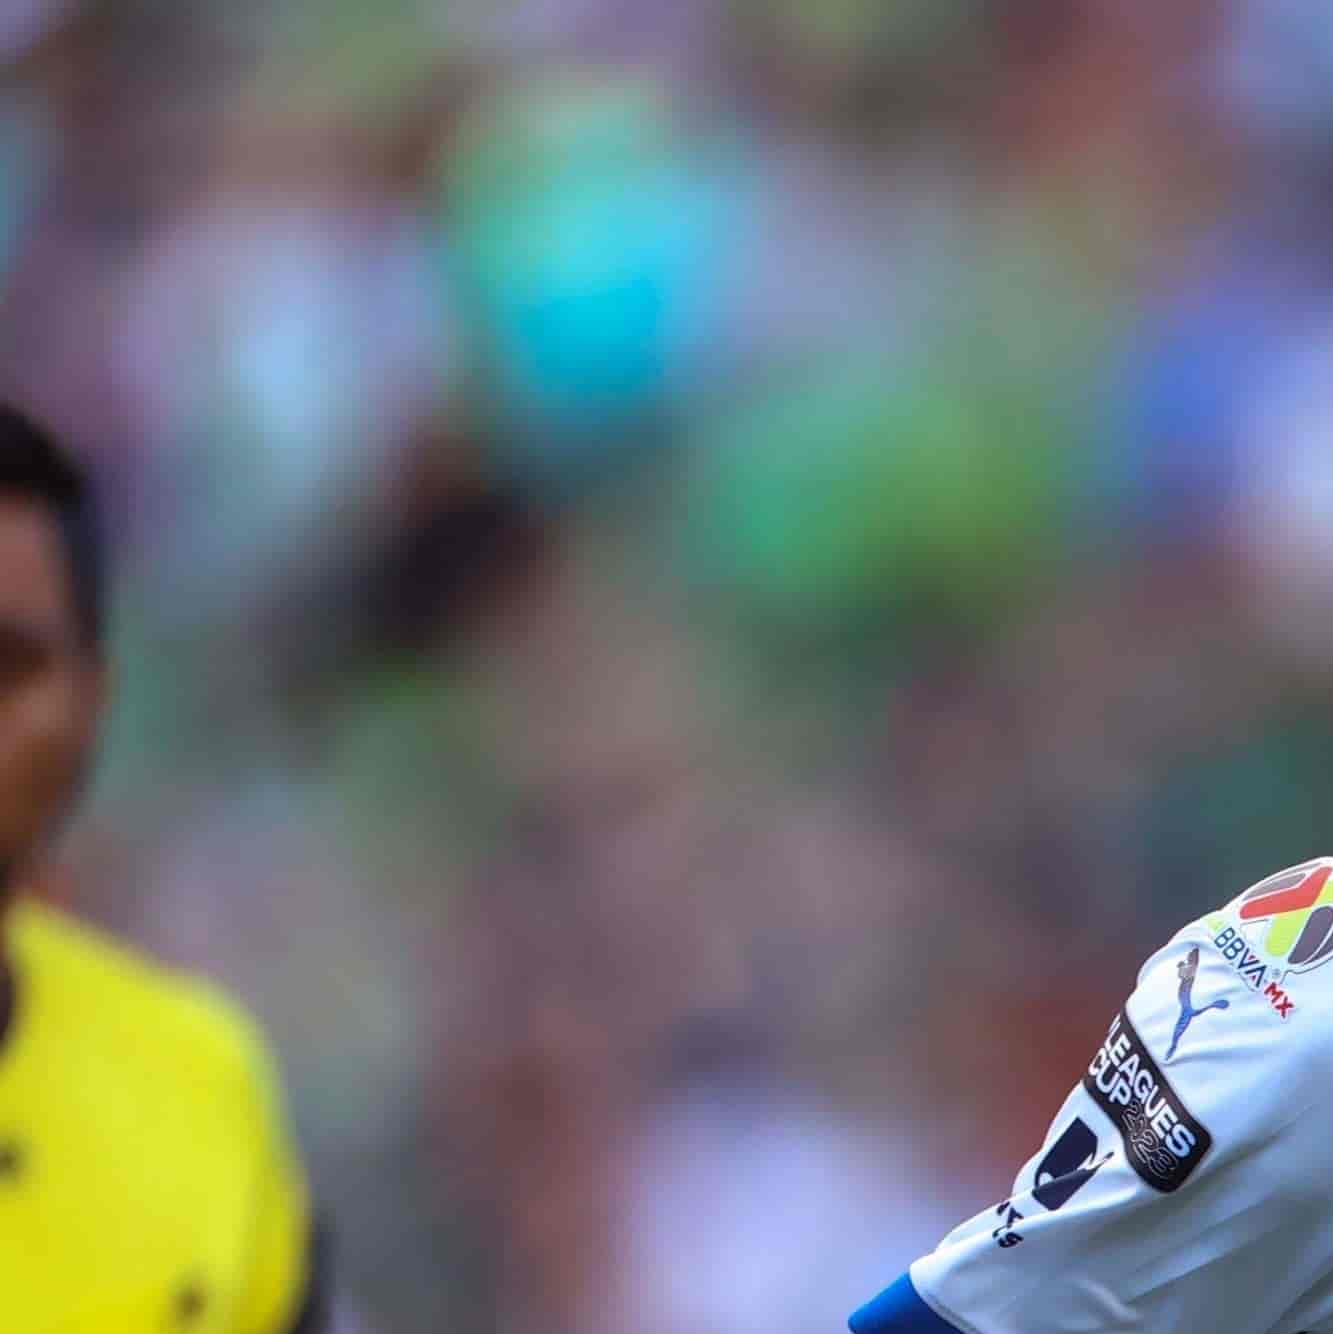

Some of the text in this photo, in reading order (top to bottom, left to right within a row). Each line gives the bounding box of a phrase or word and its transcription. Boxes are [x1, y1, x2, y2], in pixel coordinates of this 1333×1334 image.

[1214, 927, 1294, 1019] BBVA MX
[1088, 1047, 1132, 1106] CUP
[1104, 1020, 1197, 1158] LEAGUES
